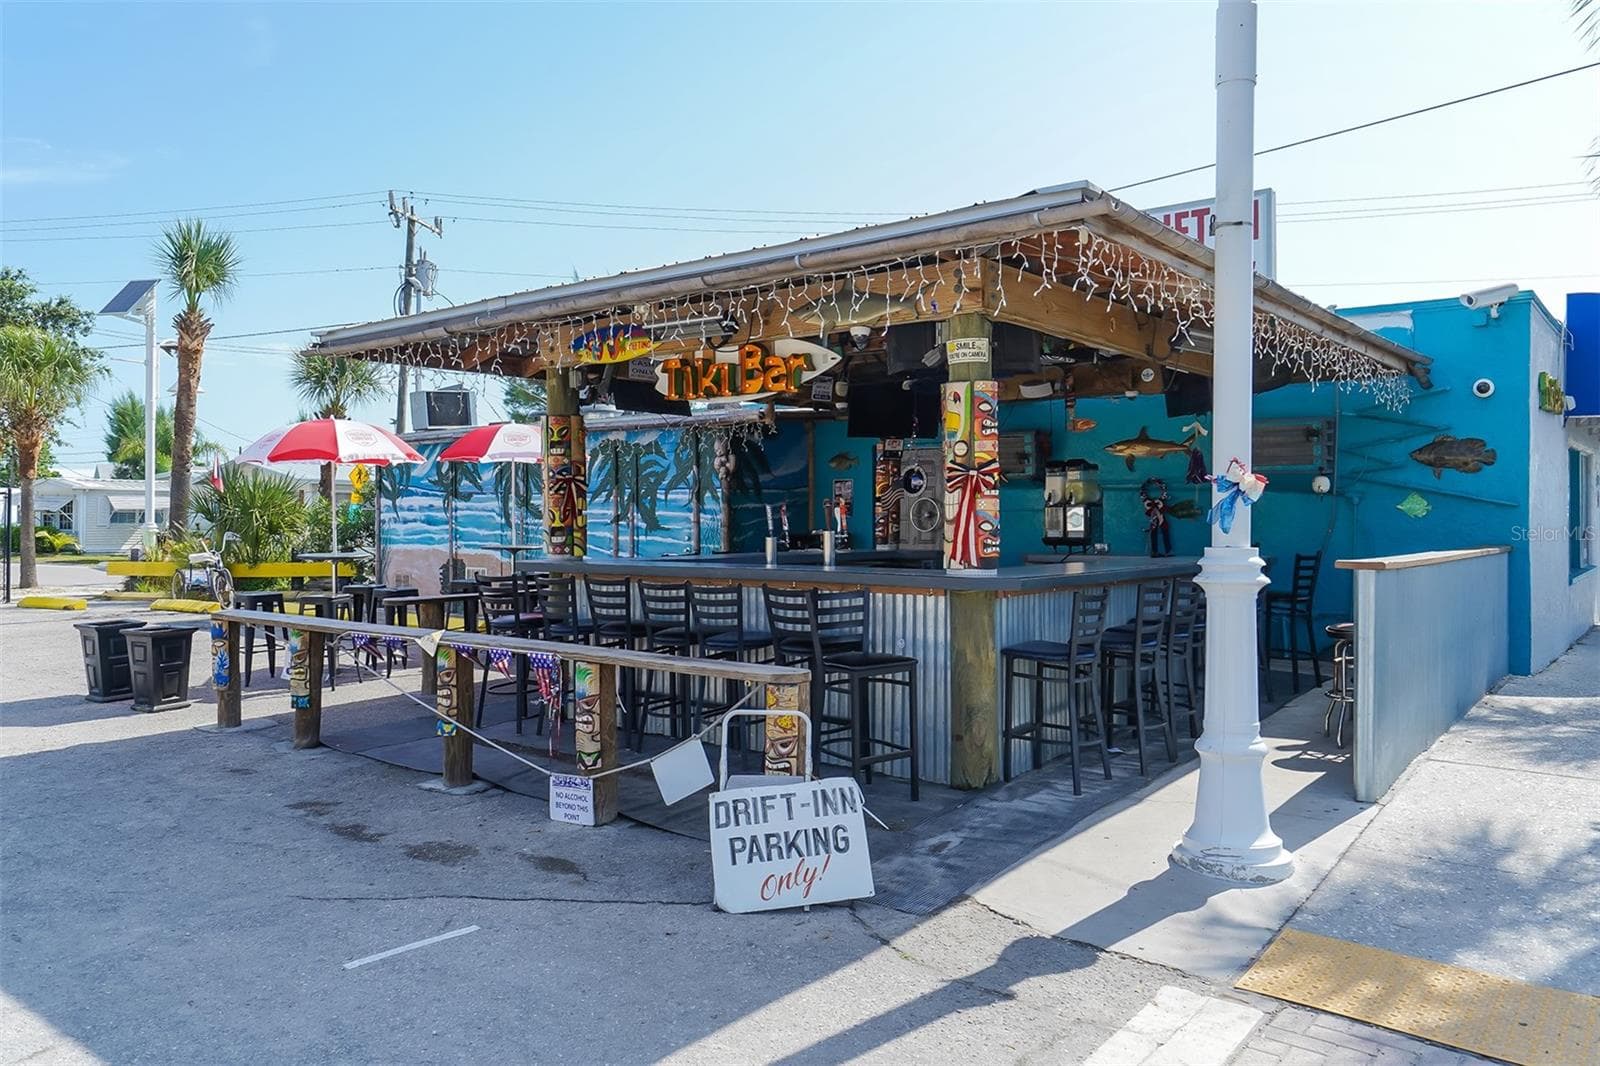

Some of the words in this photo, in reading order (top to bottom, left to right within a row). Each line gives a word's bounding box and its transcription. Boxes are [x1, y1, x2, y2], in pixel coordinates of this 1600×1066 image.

[956, 341, 976, 350] SMILE
[738, 342, 813, 394] Bar
[555, 791, 563, 799] NO
[564, 792, 589, 803] ALCOHOL
[555, 801, 576, 810] BEYOND
[577, 804, 589, 813] THIS
[714, 786, 858, 830] DRIFT-INN
[563, 812, 580, 821] POINT
[728, 824, 850, 866] PARKING
[760, 852, 832, 901] Only!
